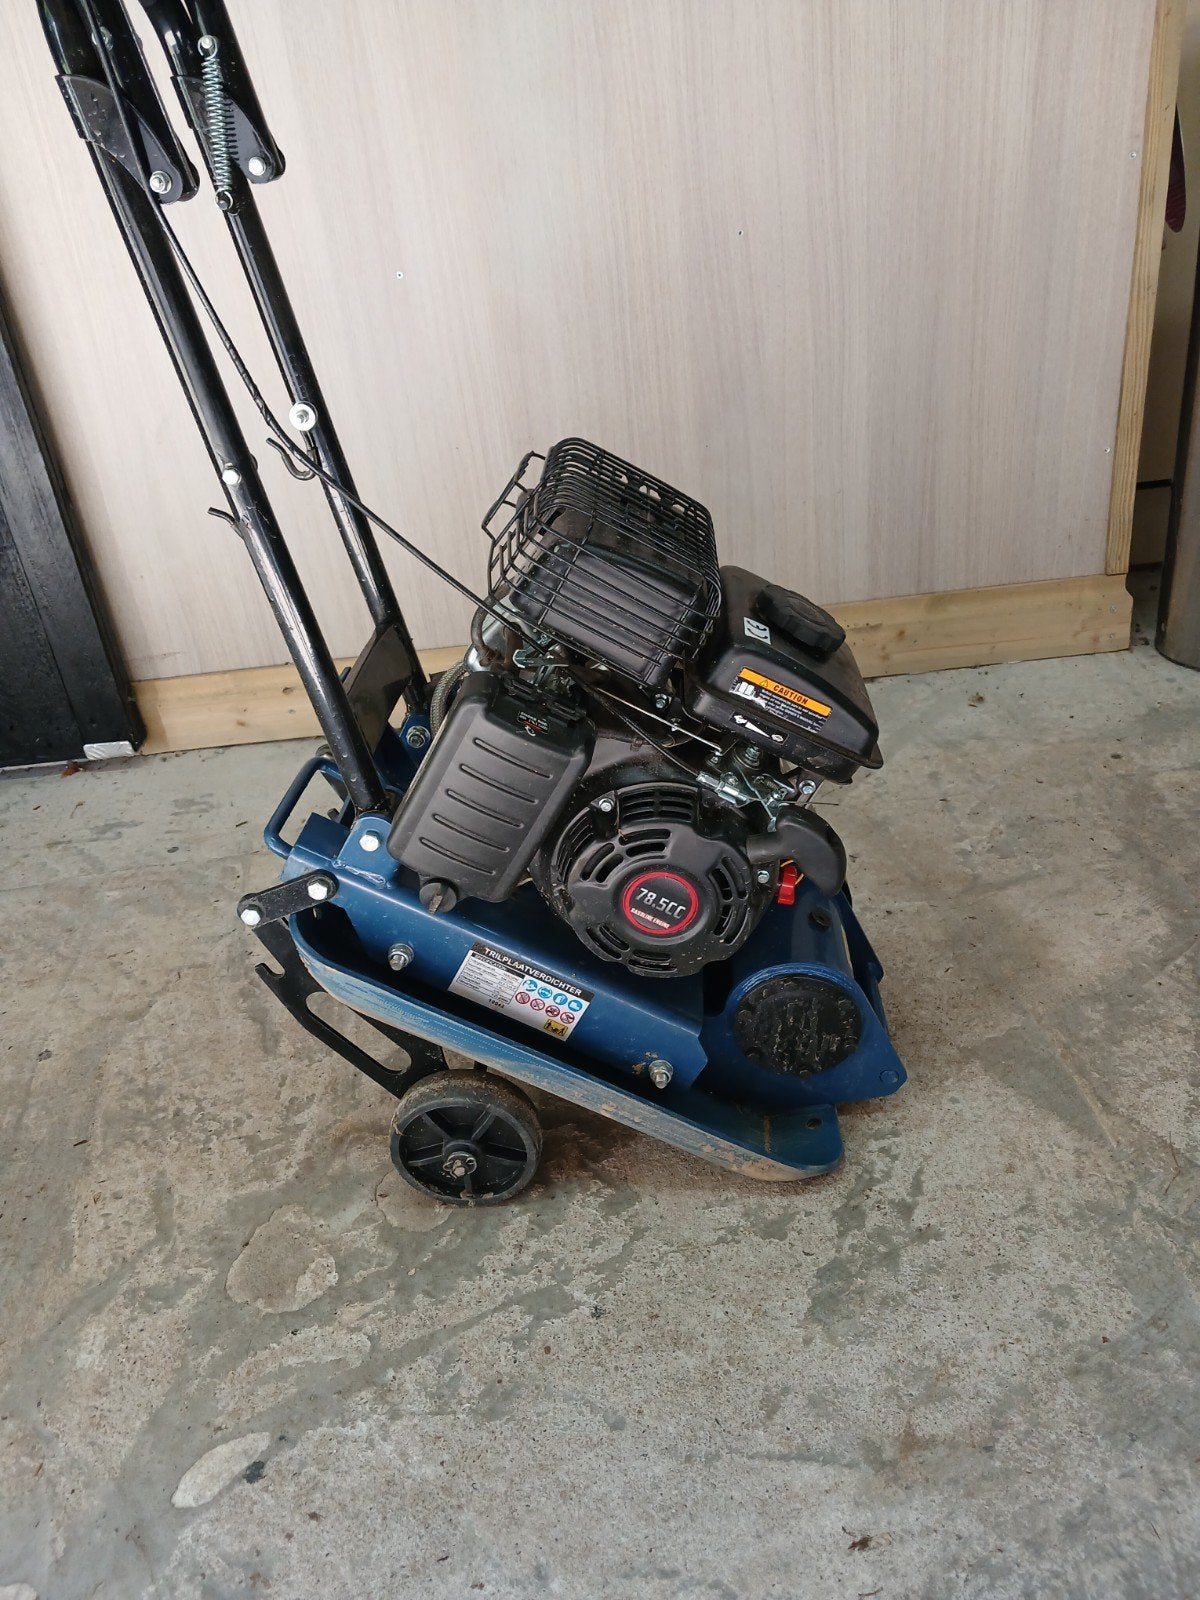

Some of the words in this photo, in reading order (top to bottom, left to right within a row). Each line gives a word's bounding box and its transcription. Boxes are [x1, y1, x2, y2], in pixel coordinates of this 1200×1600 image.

[773, 684, 809, 706] CAUTION
[635, 887, 687, 919] 78.5CC
[630, 907, 653, 923] GASOLINE
[653, 916, 671, 930] ENGINE
[484, 947, 583, 996] TRILPLAATVERDICHTER
